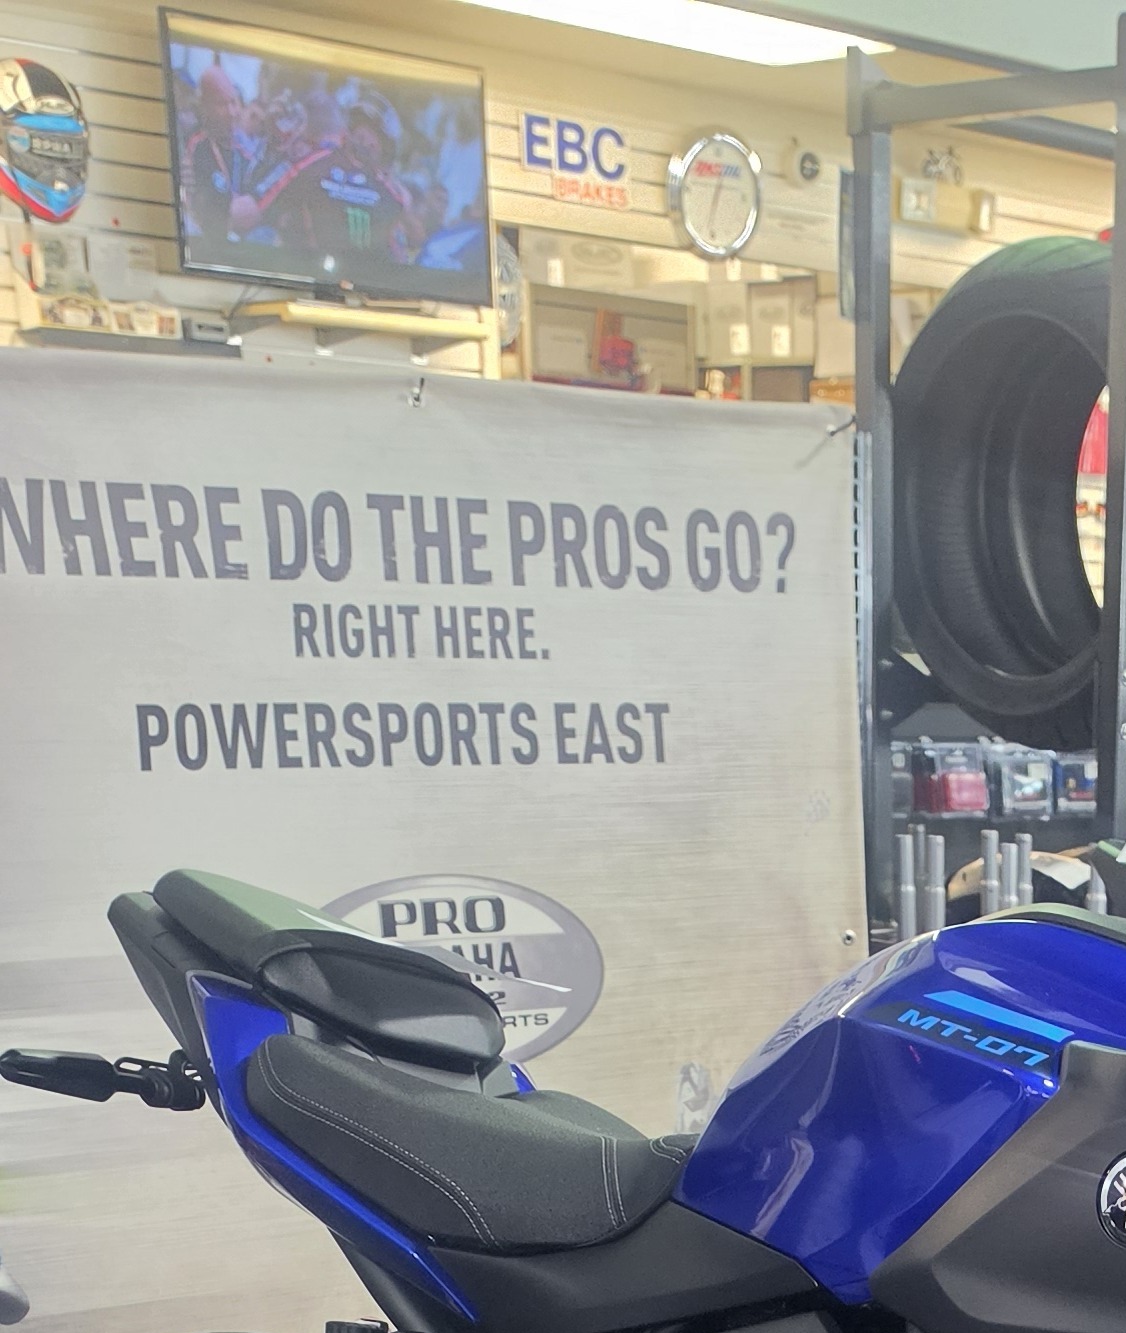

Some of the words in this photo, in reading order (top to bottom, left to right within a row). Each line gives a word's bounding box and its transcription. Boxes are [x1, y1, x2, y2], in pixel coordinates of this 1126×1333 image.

[524, 112, 625, 182] EBC
[554, 177, 628, 208] BRAKES
[260, 488, 352, 583] DO
[366, 492, 493, 586] THE
[507, 500, 672, 591] PROS
[685, 507, 796, 594] GO?
[292, 602, 420, 659] RIGHT
[434, 605, 550, 660] HERE.
[135, 702, 540, 772] POWERSPORTS
[552, 702, 671, 766] EAST
[377, 895, 506, 938] PRO
[897, 1008, 1050, 1067] MT-07
